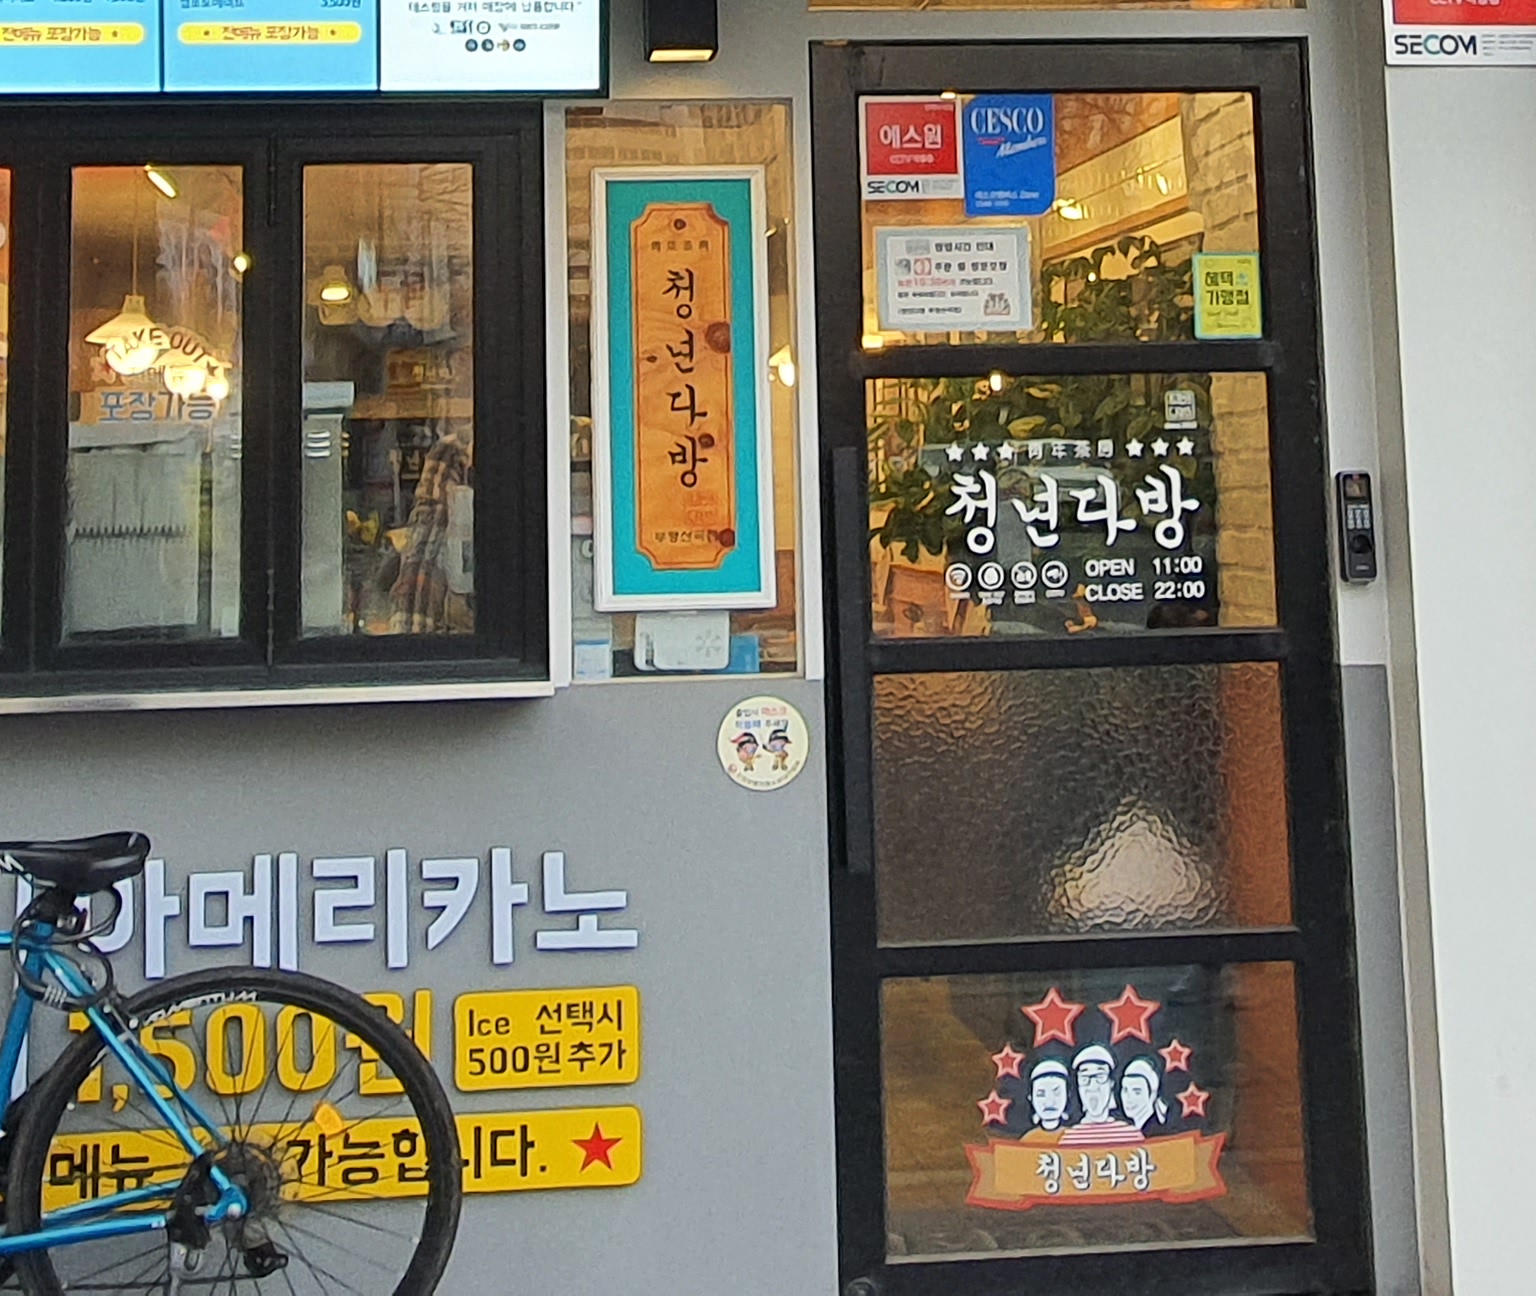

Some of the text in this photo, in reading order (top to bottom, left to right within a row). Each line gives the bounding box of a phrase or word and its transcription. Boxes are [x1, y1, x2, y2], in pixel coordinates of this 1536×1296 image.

[1394, 34, 1478, 56] SECOM
[879, 123, 943, 149] 에스원
[970, 107, 1044, 134] CESCO
[867, 180, 920, 194] SECOM
[113, 328, 211, 363] TAKE OUT
[662, 268, 709, 488] 청년다방
[100, 391, 215, 422] 포장가능
[945, 464, 1200, 554] 청년다방
[1085, 556, 1203, 578] OPEN 11:00
[1085, 581, 1205, 602] CLOSE 22:00
[74, 847, 640, 979] 아메리카노
[468, 1000, 624, 1037] Ice 선택시
[1035, 1148, 1157, 1195] 청년다방
